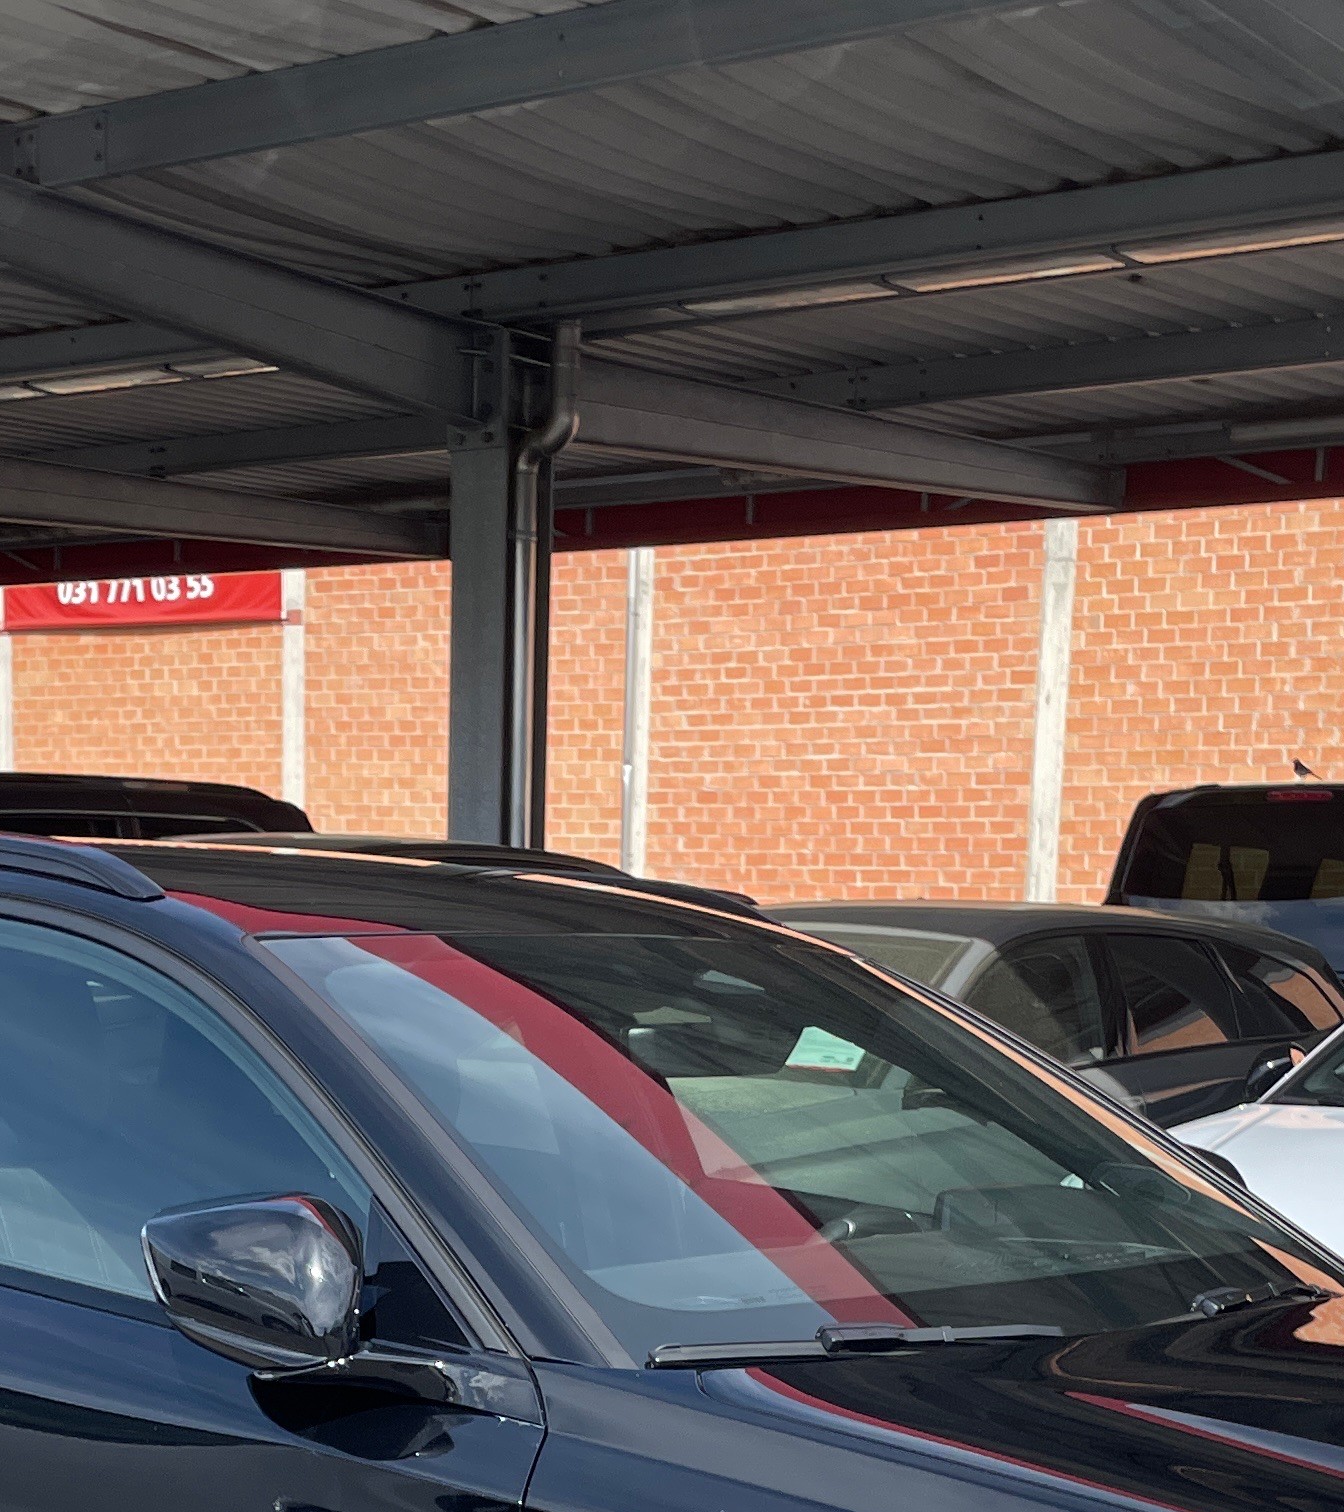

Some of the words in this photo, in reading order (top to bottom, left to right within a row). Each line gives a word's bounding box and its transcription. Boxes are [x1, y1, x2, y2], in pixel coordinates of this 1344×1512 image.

[57, 580, 99, 605] 031
[151, 575, 181, 601] 03
[186, 574, 215, 599] 55
